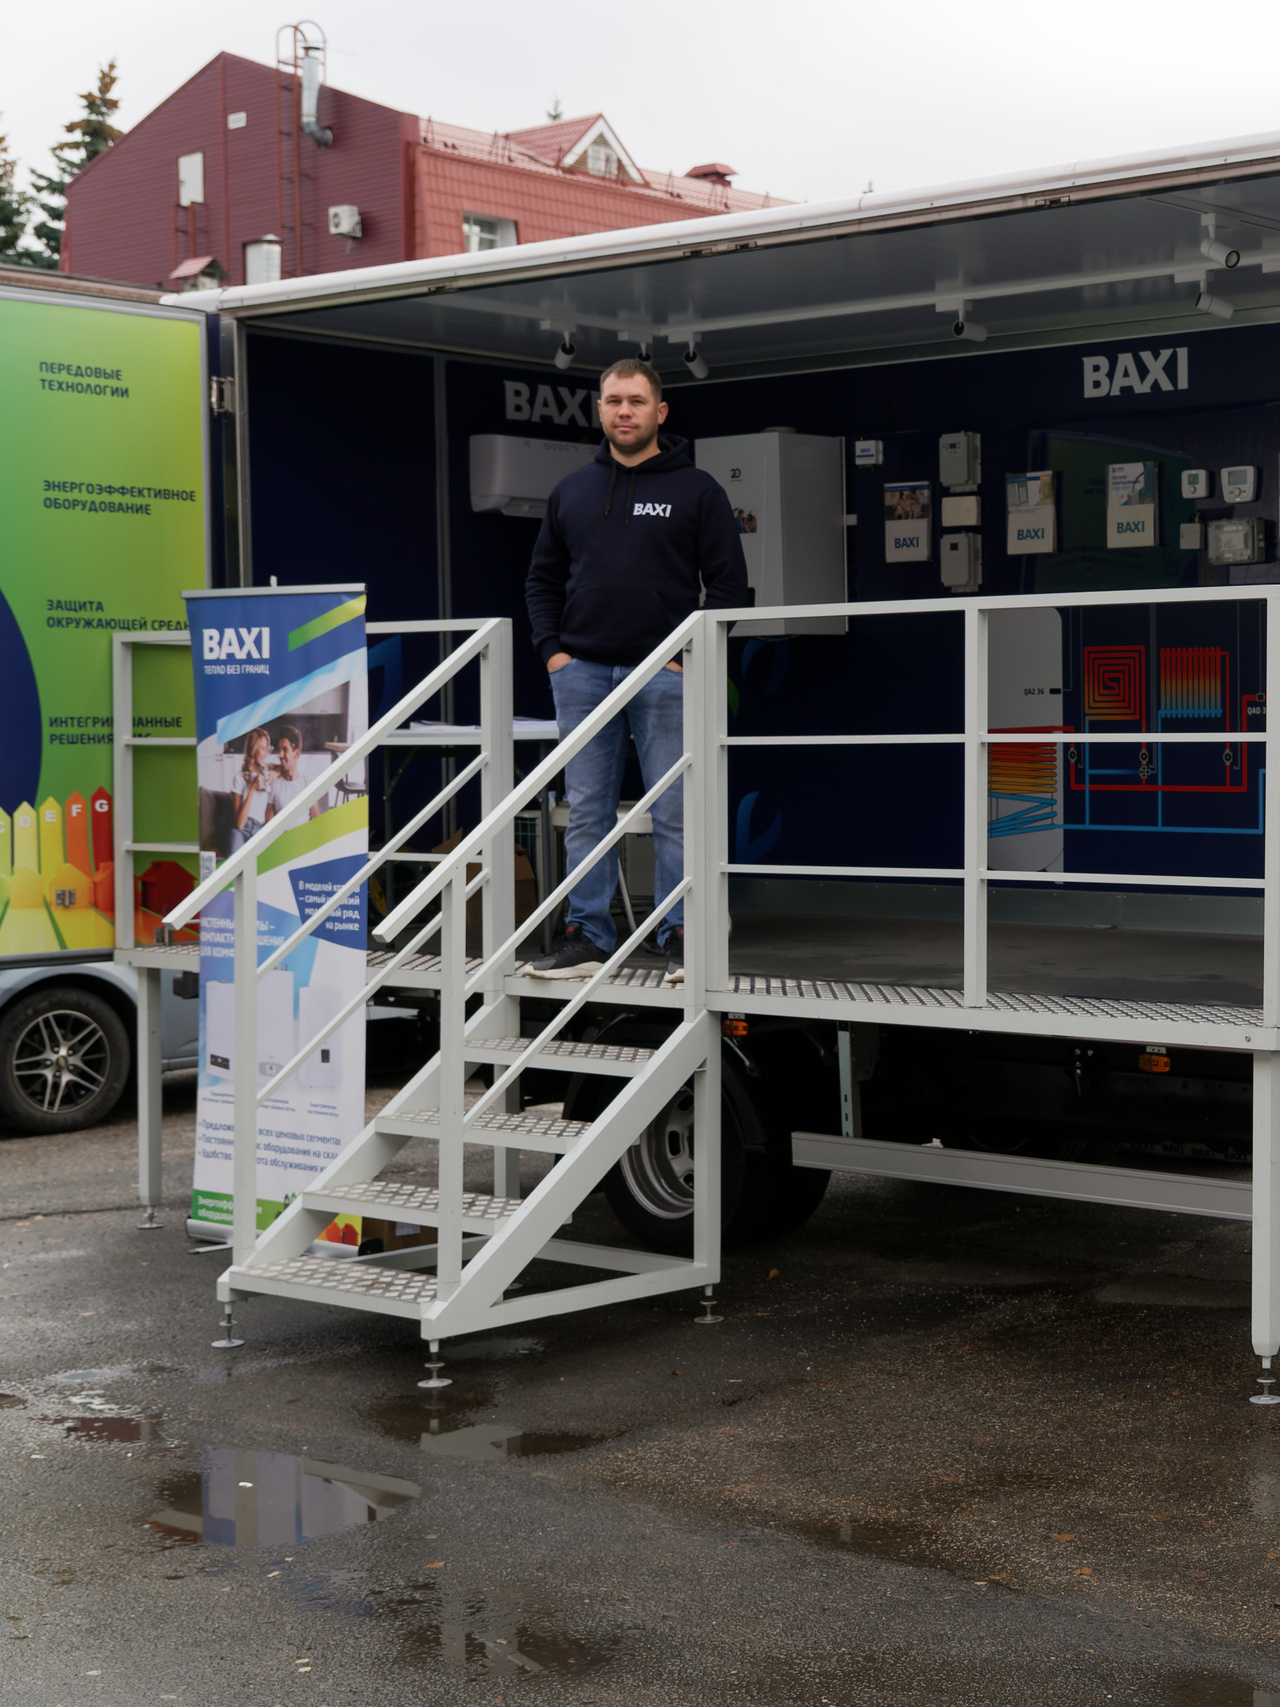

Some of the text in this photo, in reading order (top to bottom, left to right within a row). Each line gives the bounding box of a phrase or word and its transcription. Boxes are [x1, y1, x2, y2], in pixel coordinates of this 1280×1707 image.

[39, 361, 123, 381] ПЕРЕДОВЫЕ
[1082, 346, 1189, 399] BAXI
[40, 378, 130, 399] ТЕХНОЛОГИИ
[43, 480, 197, 502] ЭНЕРГОЭФФЕКТИВНОЕ
[43, 497, 152, 516] ОБОРУДОВАНИЕ
[633, 502, 672, 518] BAXI
[1017, 527, 1045, 541] BAXI
[1117, 520, 1145, 534] BAXI
[894, 536, 919, 549] BAXI
[46, 599, 105, 613] ЗАЩИТА
[46, 616, 148, 631] ОКРУЖАЮЩЕЙ
[202, 627, 271, 660] BAXI
[204, 664, 270, 676] ТЕПЛО БЕЗ ГРАНИЦ
[50, 733, 114, 745] РЕШЕНИЯ
[19, 816, 32, 828] D
[45, 810, 57, 823] E
[71, 804, 82, 817] F
[95, 799, 109, 813] G
[342, 910, 360, 920] ряд
[334, 922, 360, 931] рынке
